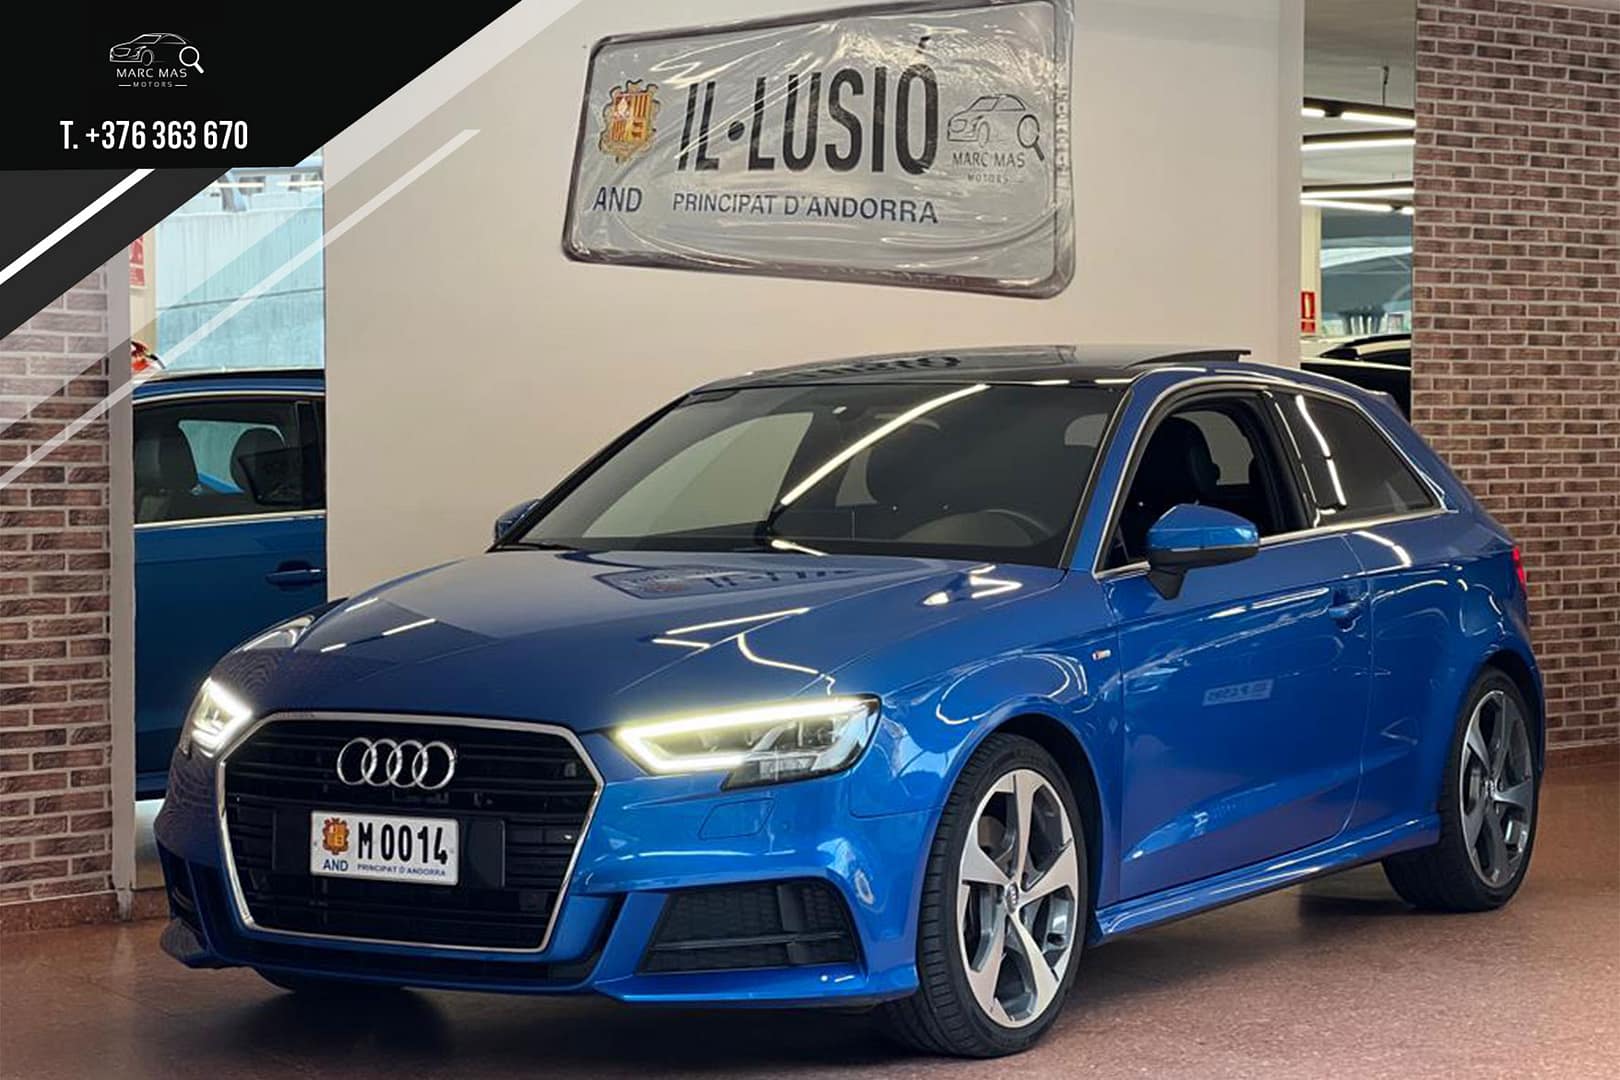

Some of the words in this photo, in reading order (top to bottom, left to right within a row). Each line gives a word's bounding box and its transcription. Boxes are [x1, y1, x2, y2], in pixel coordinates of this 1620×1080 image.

[952, 151, 989, 167] MARC
[994, 151, 1026, 168] MAS
[593, 186, 642, 213] AND
[672, 193, 778, 214] PRINCIPAT
[784, 195, 939, 225] D'ANDORRA
[357, 821, 373, 860] M
[380, 823, 449, 865] 0014
[323, 859, 349, 872] AND
[357, 864, 397, 873] PRINCIPAT
